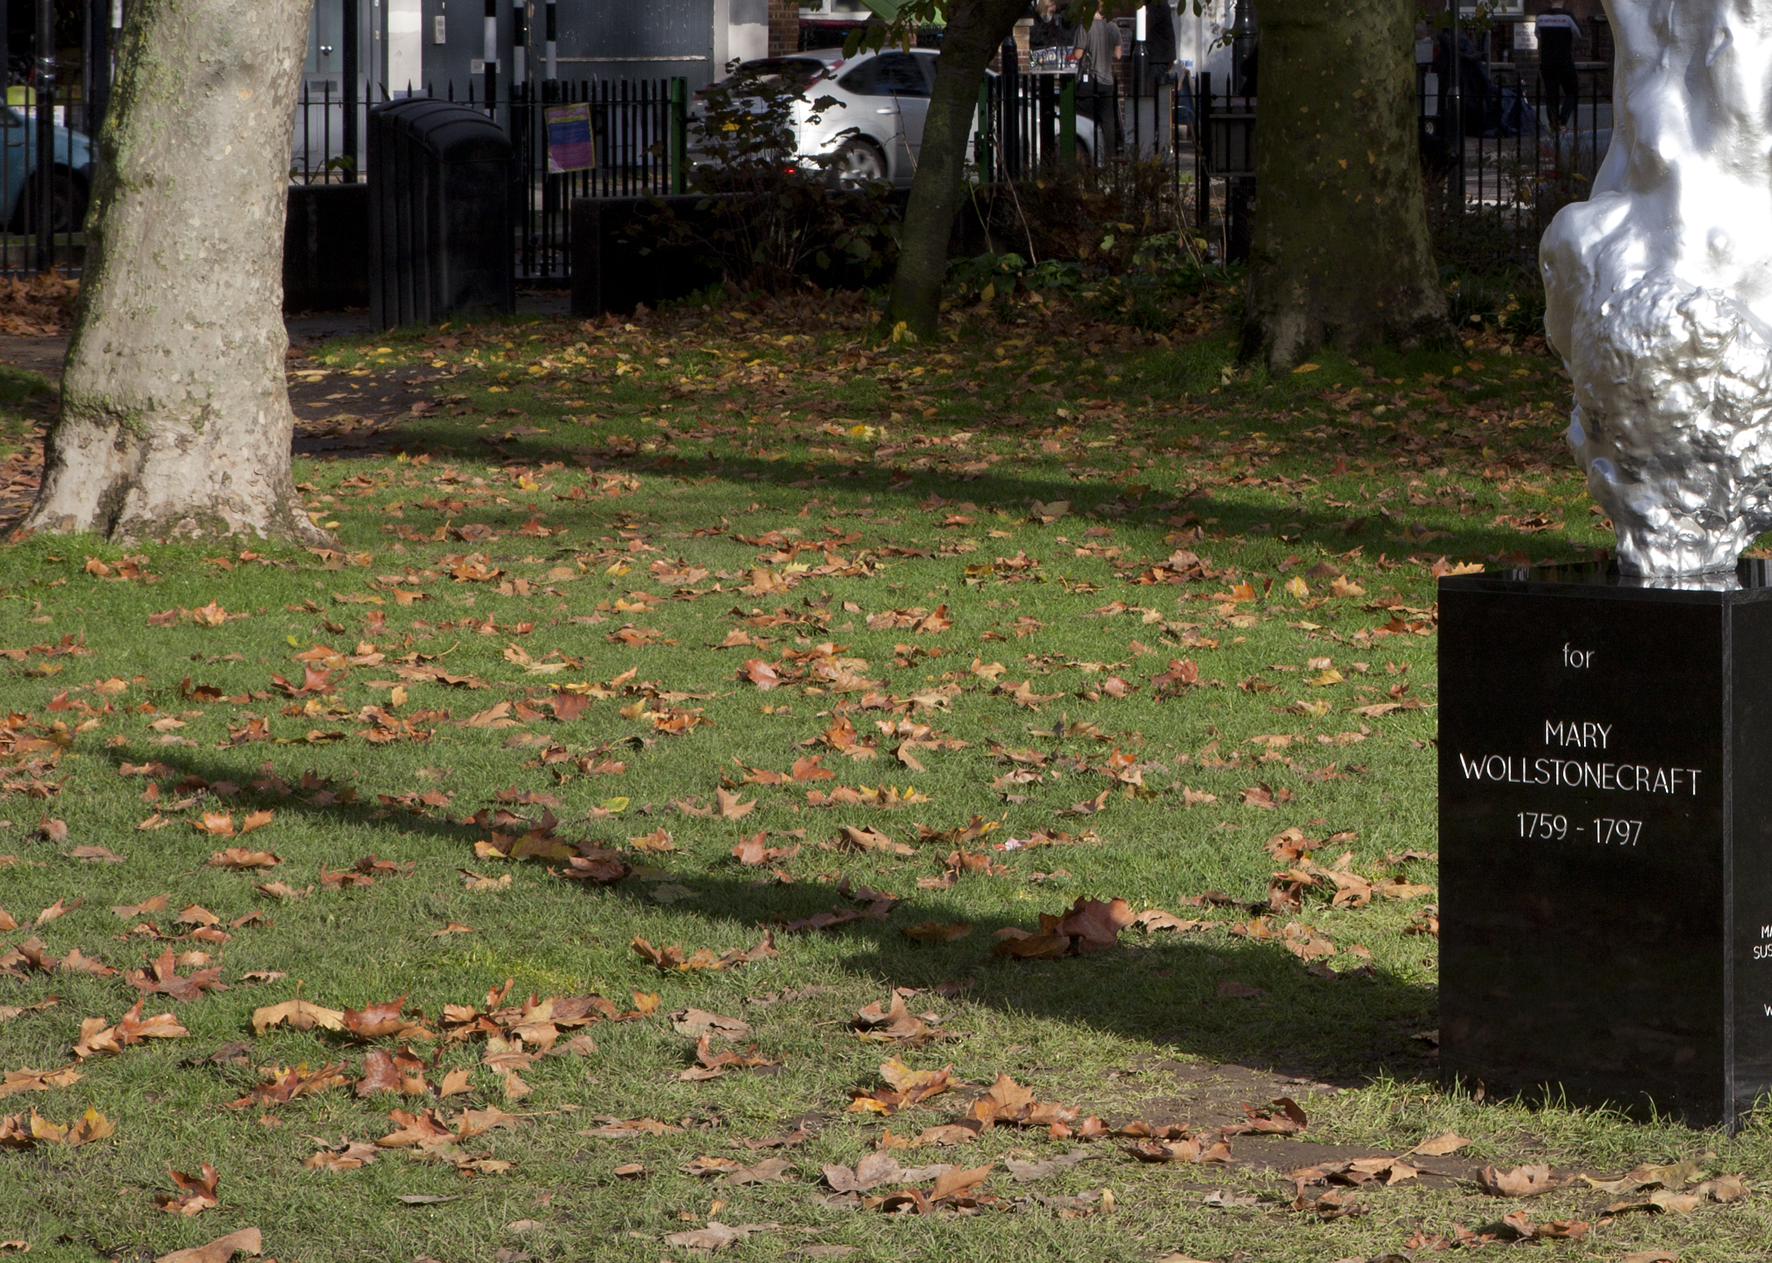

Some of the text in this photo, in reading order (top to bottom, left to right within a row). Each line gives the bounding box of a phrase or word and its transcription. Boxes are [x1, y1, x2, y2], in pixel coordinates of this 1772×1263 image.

[1562, 642, 1596, 669] for
[1545, 719, 1613, 750] MARY
[1459, 752, 1703, 796] WOLLSTONECRAFT
[1516, 811, 1568, 840] 1759
[1593, 818, 1643, 847] 1797
